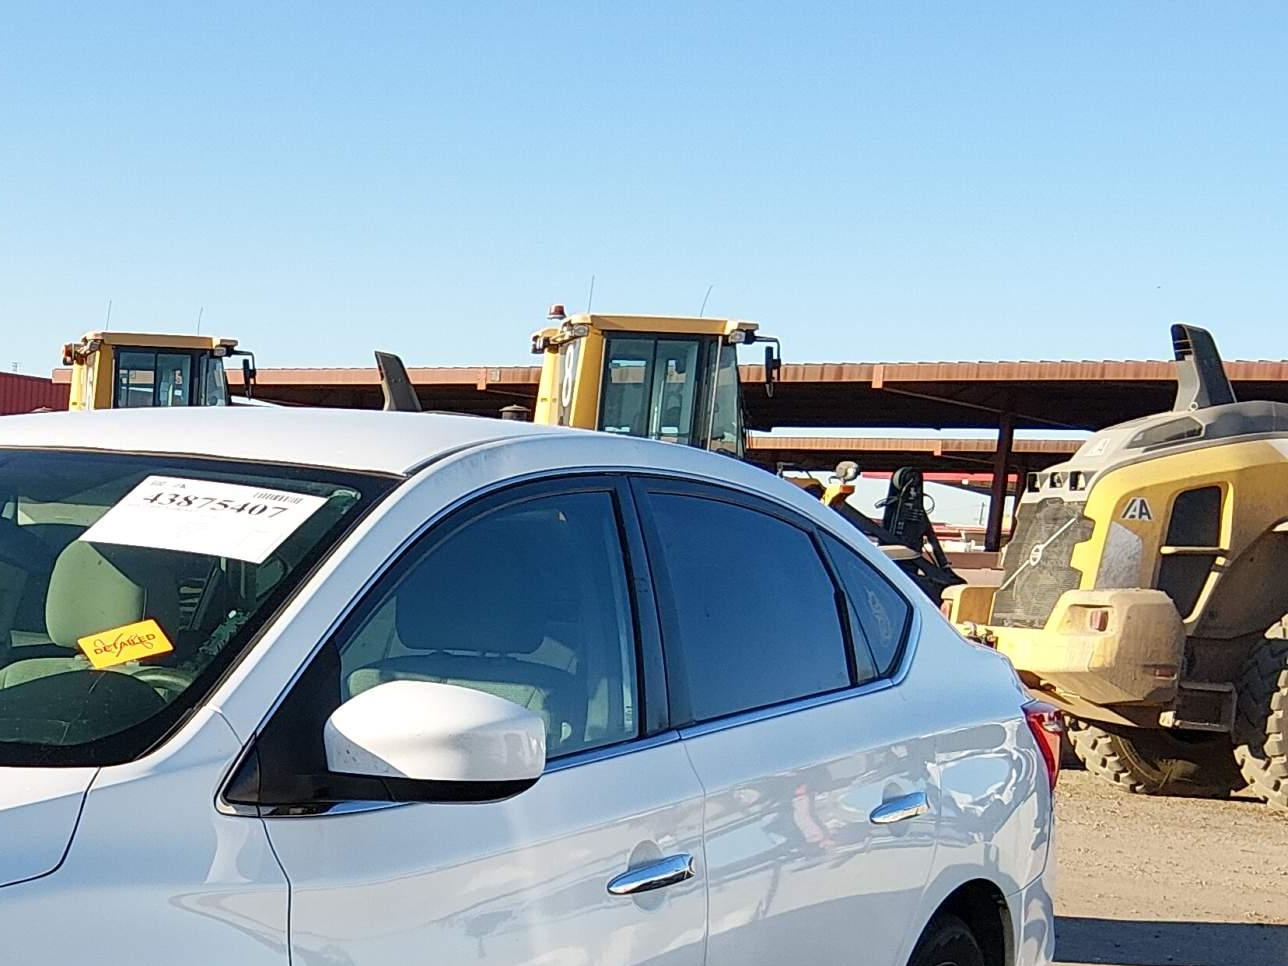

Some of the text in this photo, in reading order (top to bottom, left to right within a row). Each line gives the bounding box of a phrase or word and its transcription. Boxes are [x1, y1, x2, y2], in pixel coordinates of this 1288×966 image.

[562, 344, 574, 407] 8
[143, 491, 289, 518] 43875407
[93, 633, 157, 656] DETAILED
